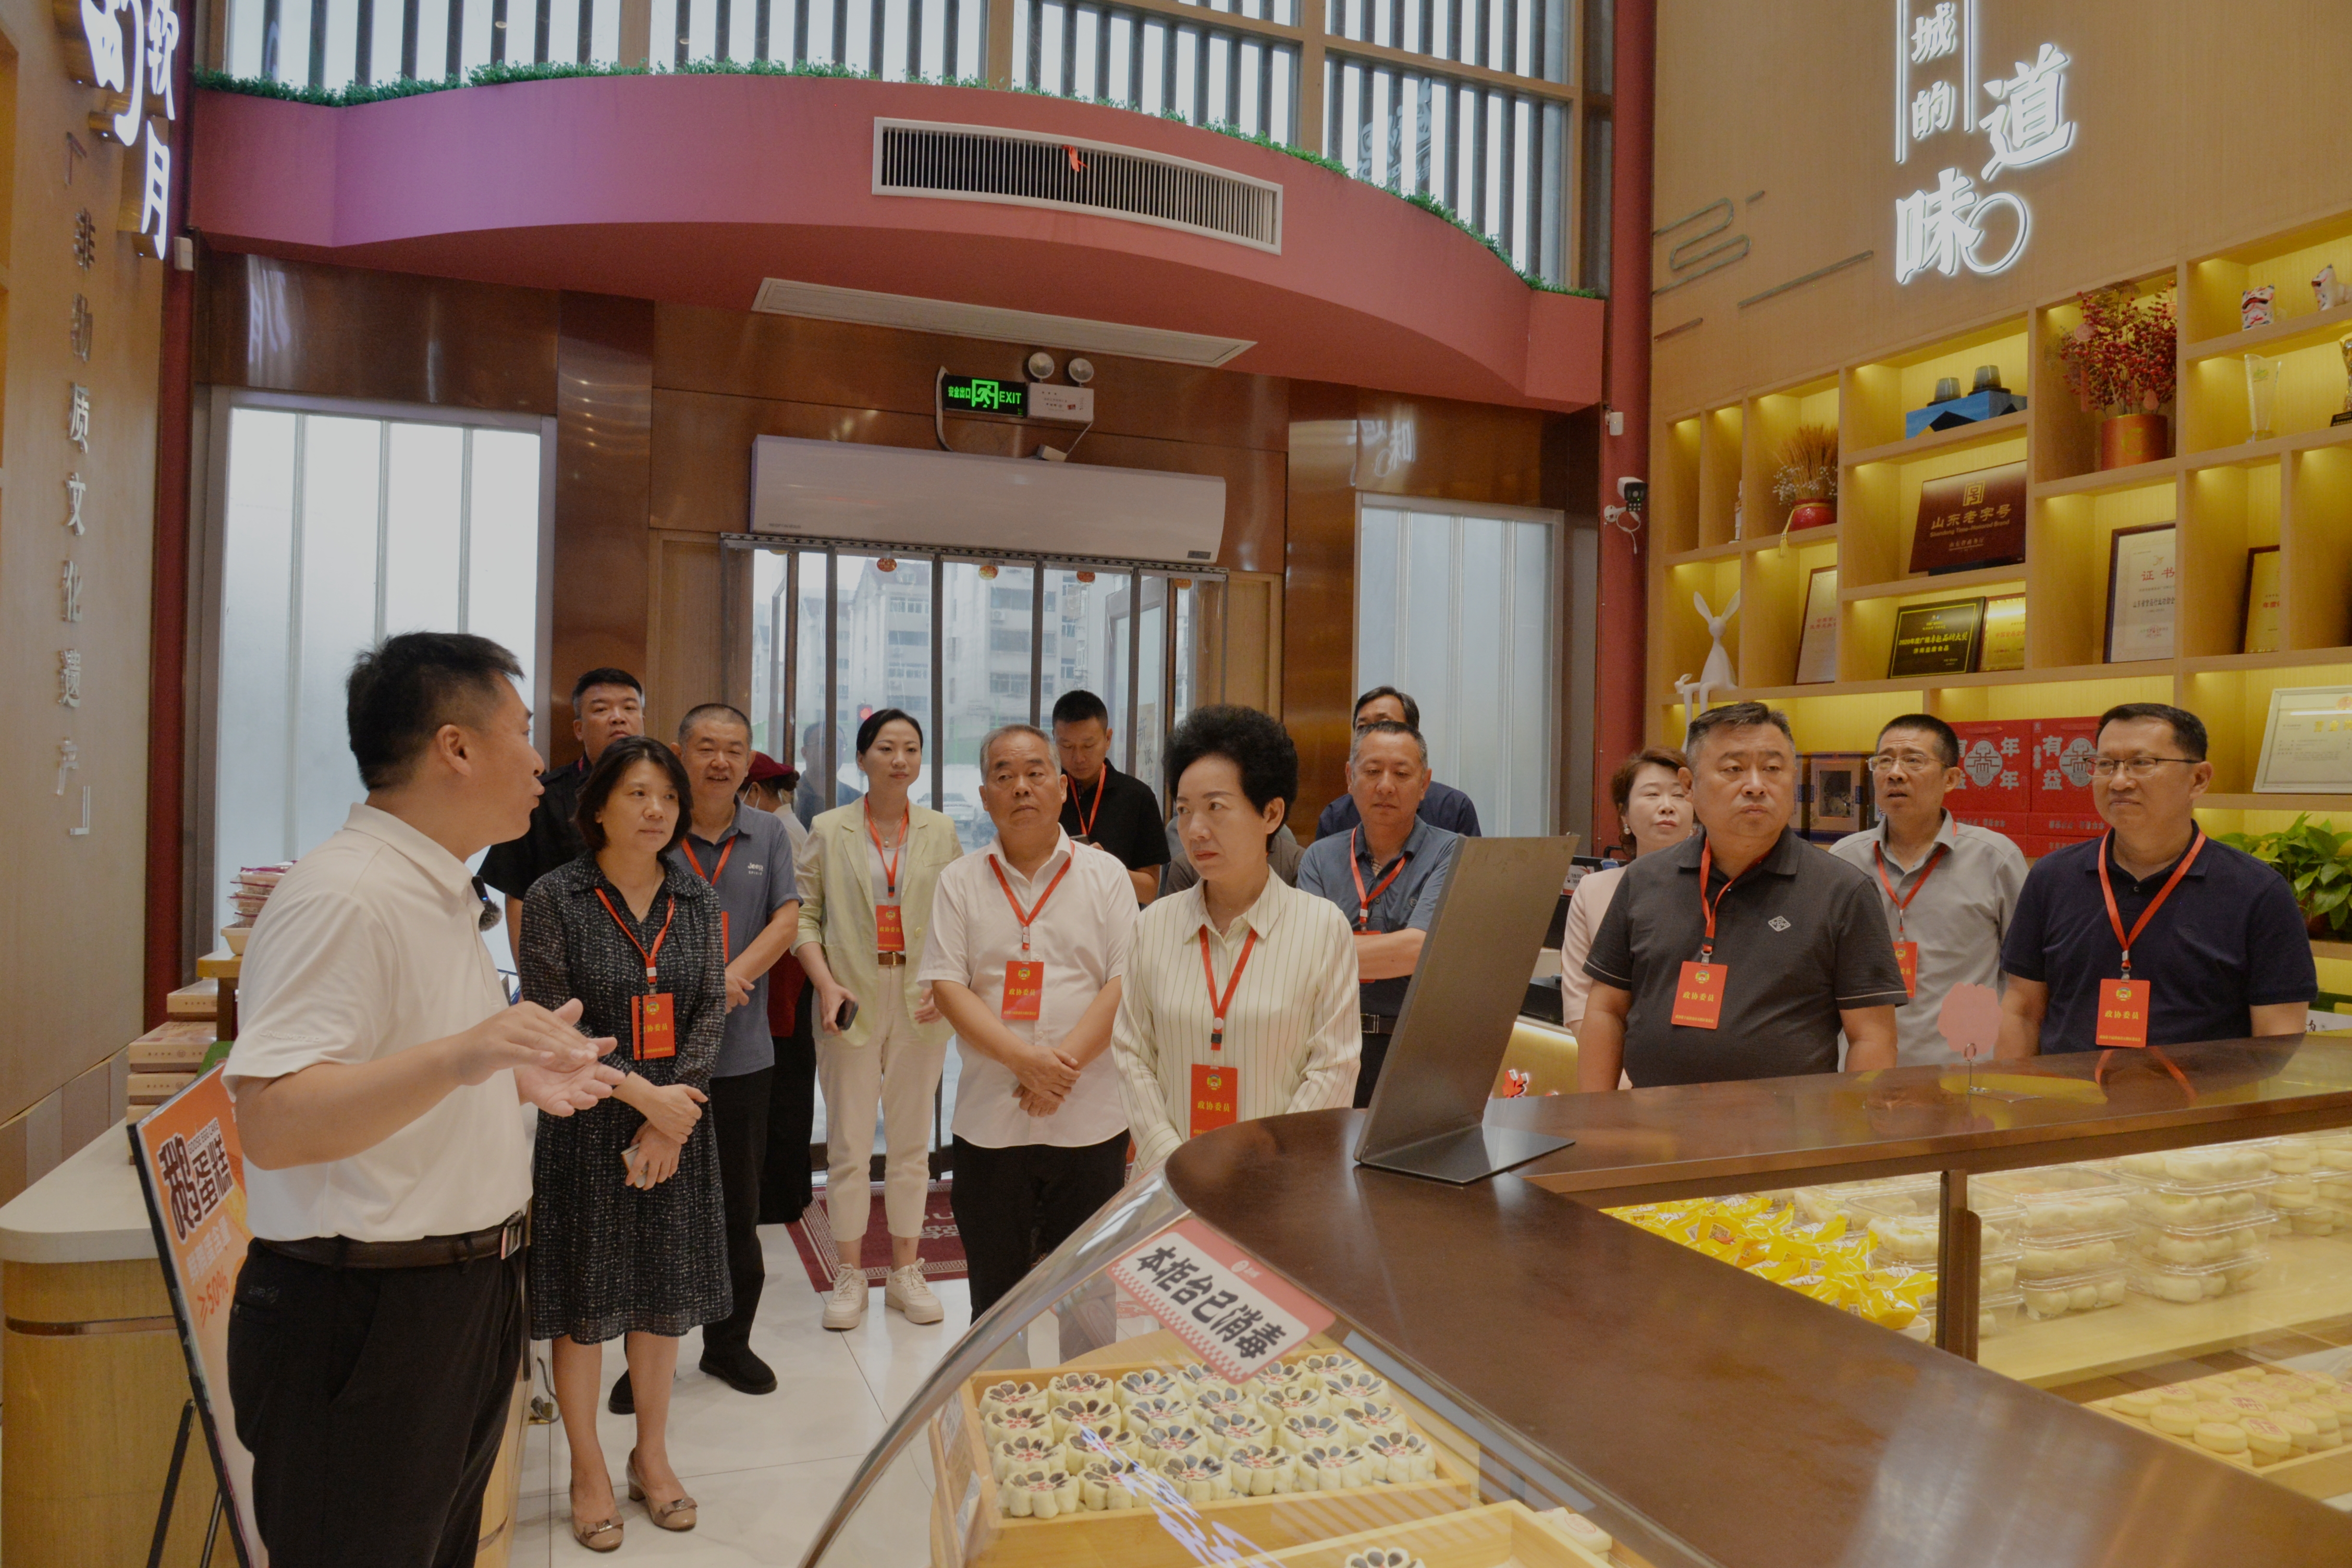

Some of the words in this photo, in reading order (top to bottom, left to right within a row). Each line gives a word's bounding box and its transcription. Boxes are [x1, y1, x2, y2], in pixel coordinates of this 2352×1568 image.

[948, 386, 971, 399] 安全出口
[999, 391, 1022, 405] EXIT
[1930, 504, 2012, 530] 山东老字号
[1994, 519, 2010, 528] Brand
[2141, 567, 2175, 582] 证书
[748, 863, 764, 872] Jeep
[1009, 988, 1036, 996] 政协委员
[1683, 991, 1714, 1002] 政协委员
[2104, 1010, 2139, 1020] 政协委员
[1197, 1100, 1230, 1112] 政协委员
[188, 1135, 202, 1155] GOOSE
[209, 1120, 218, 1135] CAKE
[1136, 1245, 1287, 1359] 本柜台已消毒
